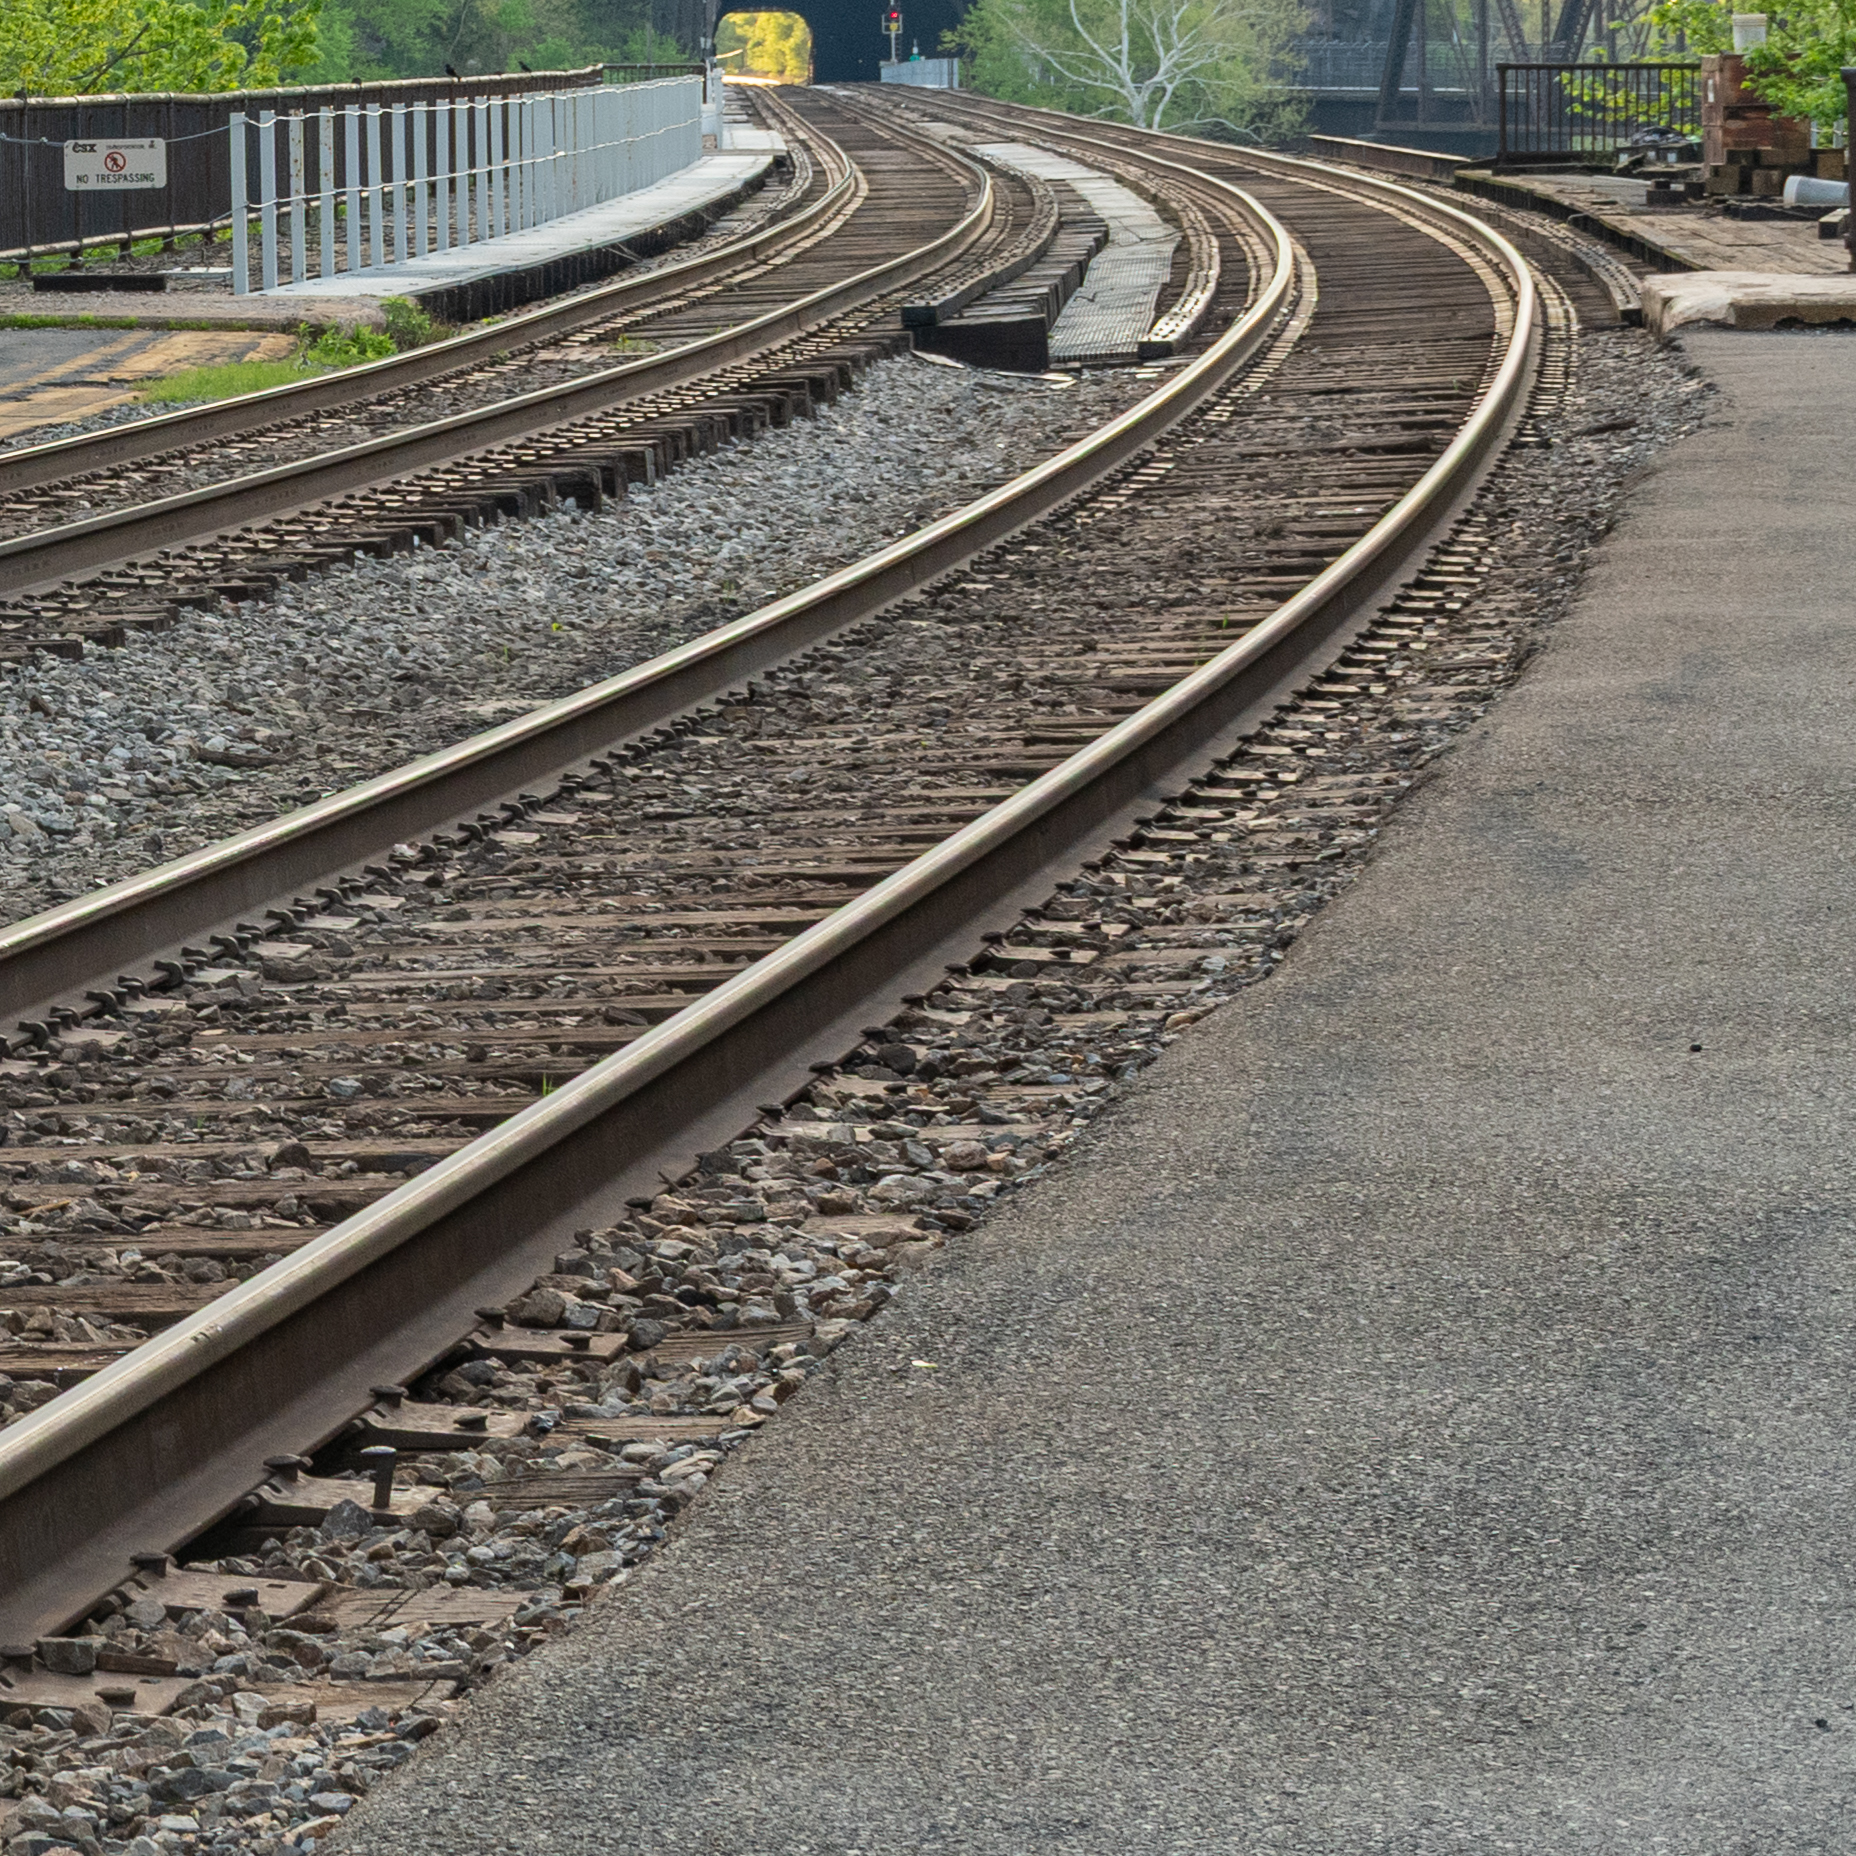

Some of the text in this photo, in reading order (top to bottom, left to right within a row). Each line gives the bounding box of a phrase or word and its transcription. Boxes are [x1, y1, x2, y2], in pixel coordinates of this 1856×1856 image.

[72, 142, 97, 153] CSX
[76, 173, 155, 184] NO TRESPASSING
